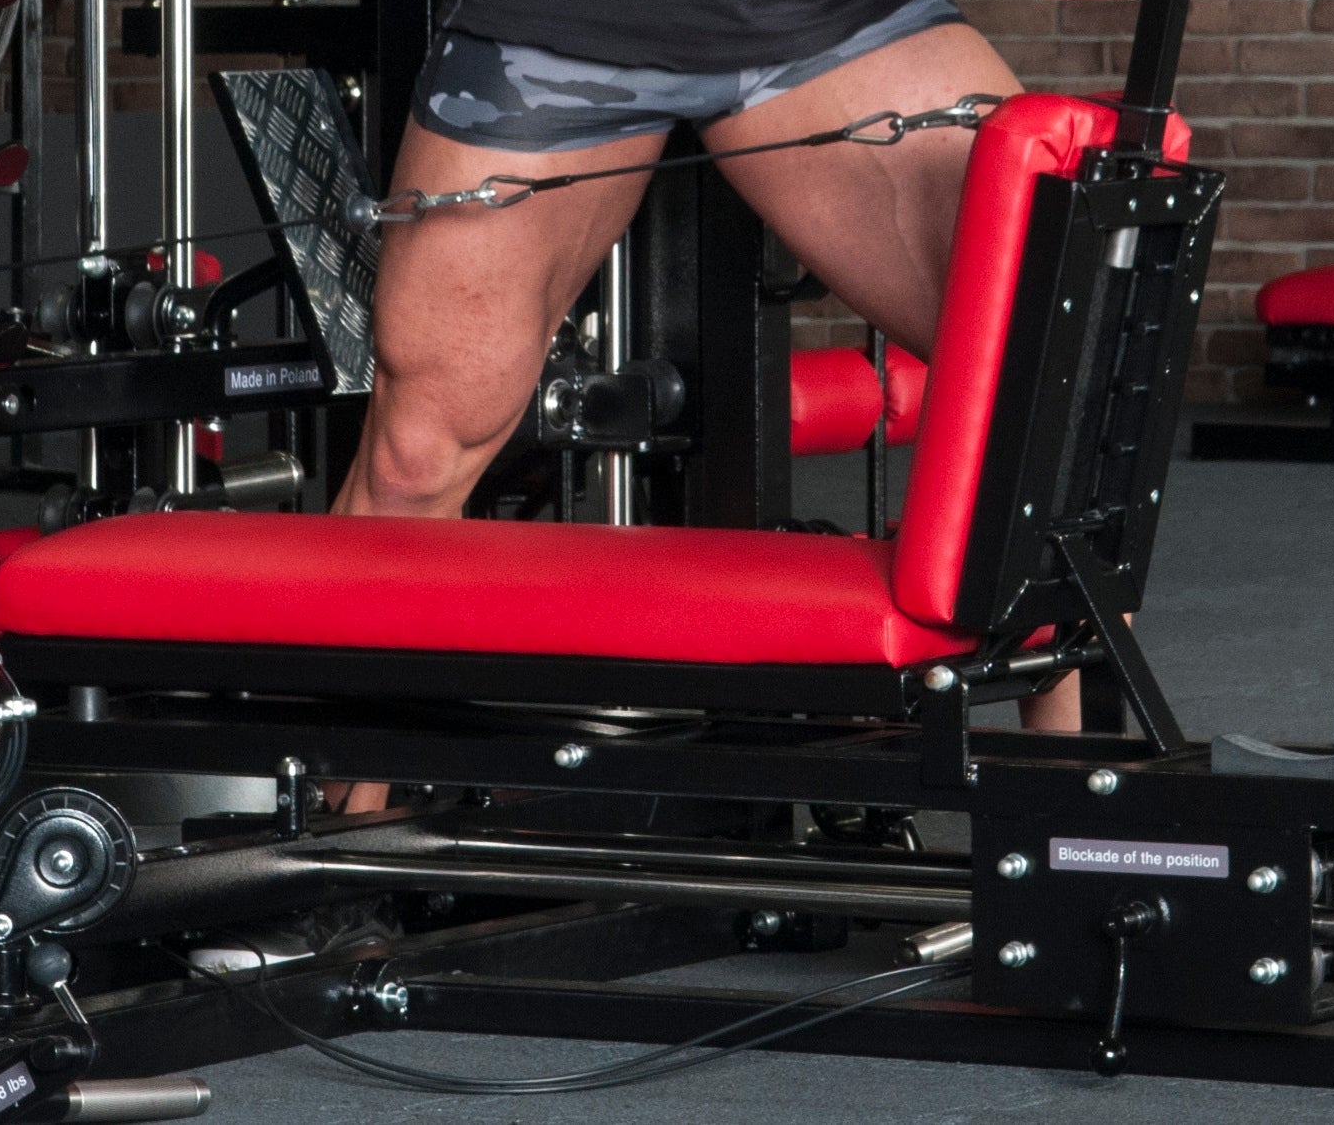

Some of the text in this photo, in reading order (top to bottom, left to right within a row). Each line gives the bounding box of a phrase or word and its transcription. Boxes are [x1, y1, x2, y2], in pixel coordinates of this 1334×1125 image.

[231, 365, 319, 389] Made in Poland
[1058, 847, 1220, 868] Blockade of the position
[7, 1075, 27, 1093] lbs
